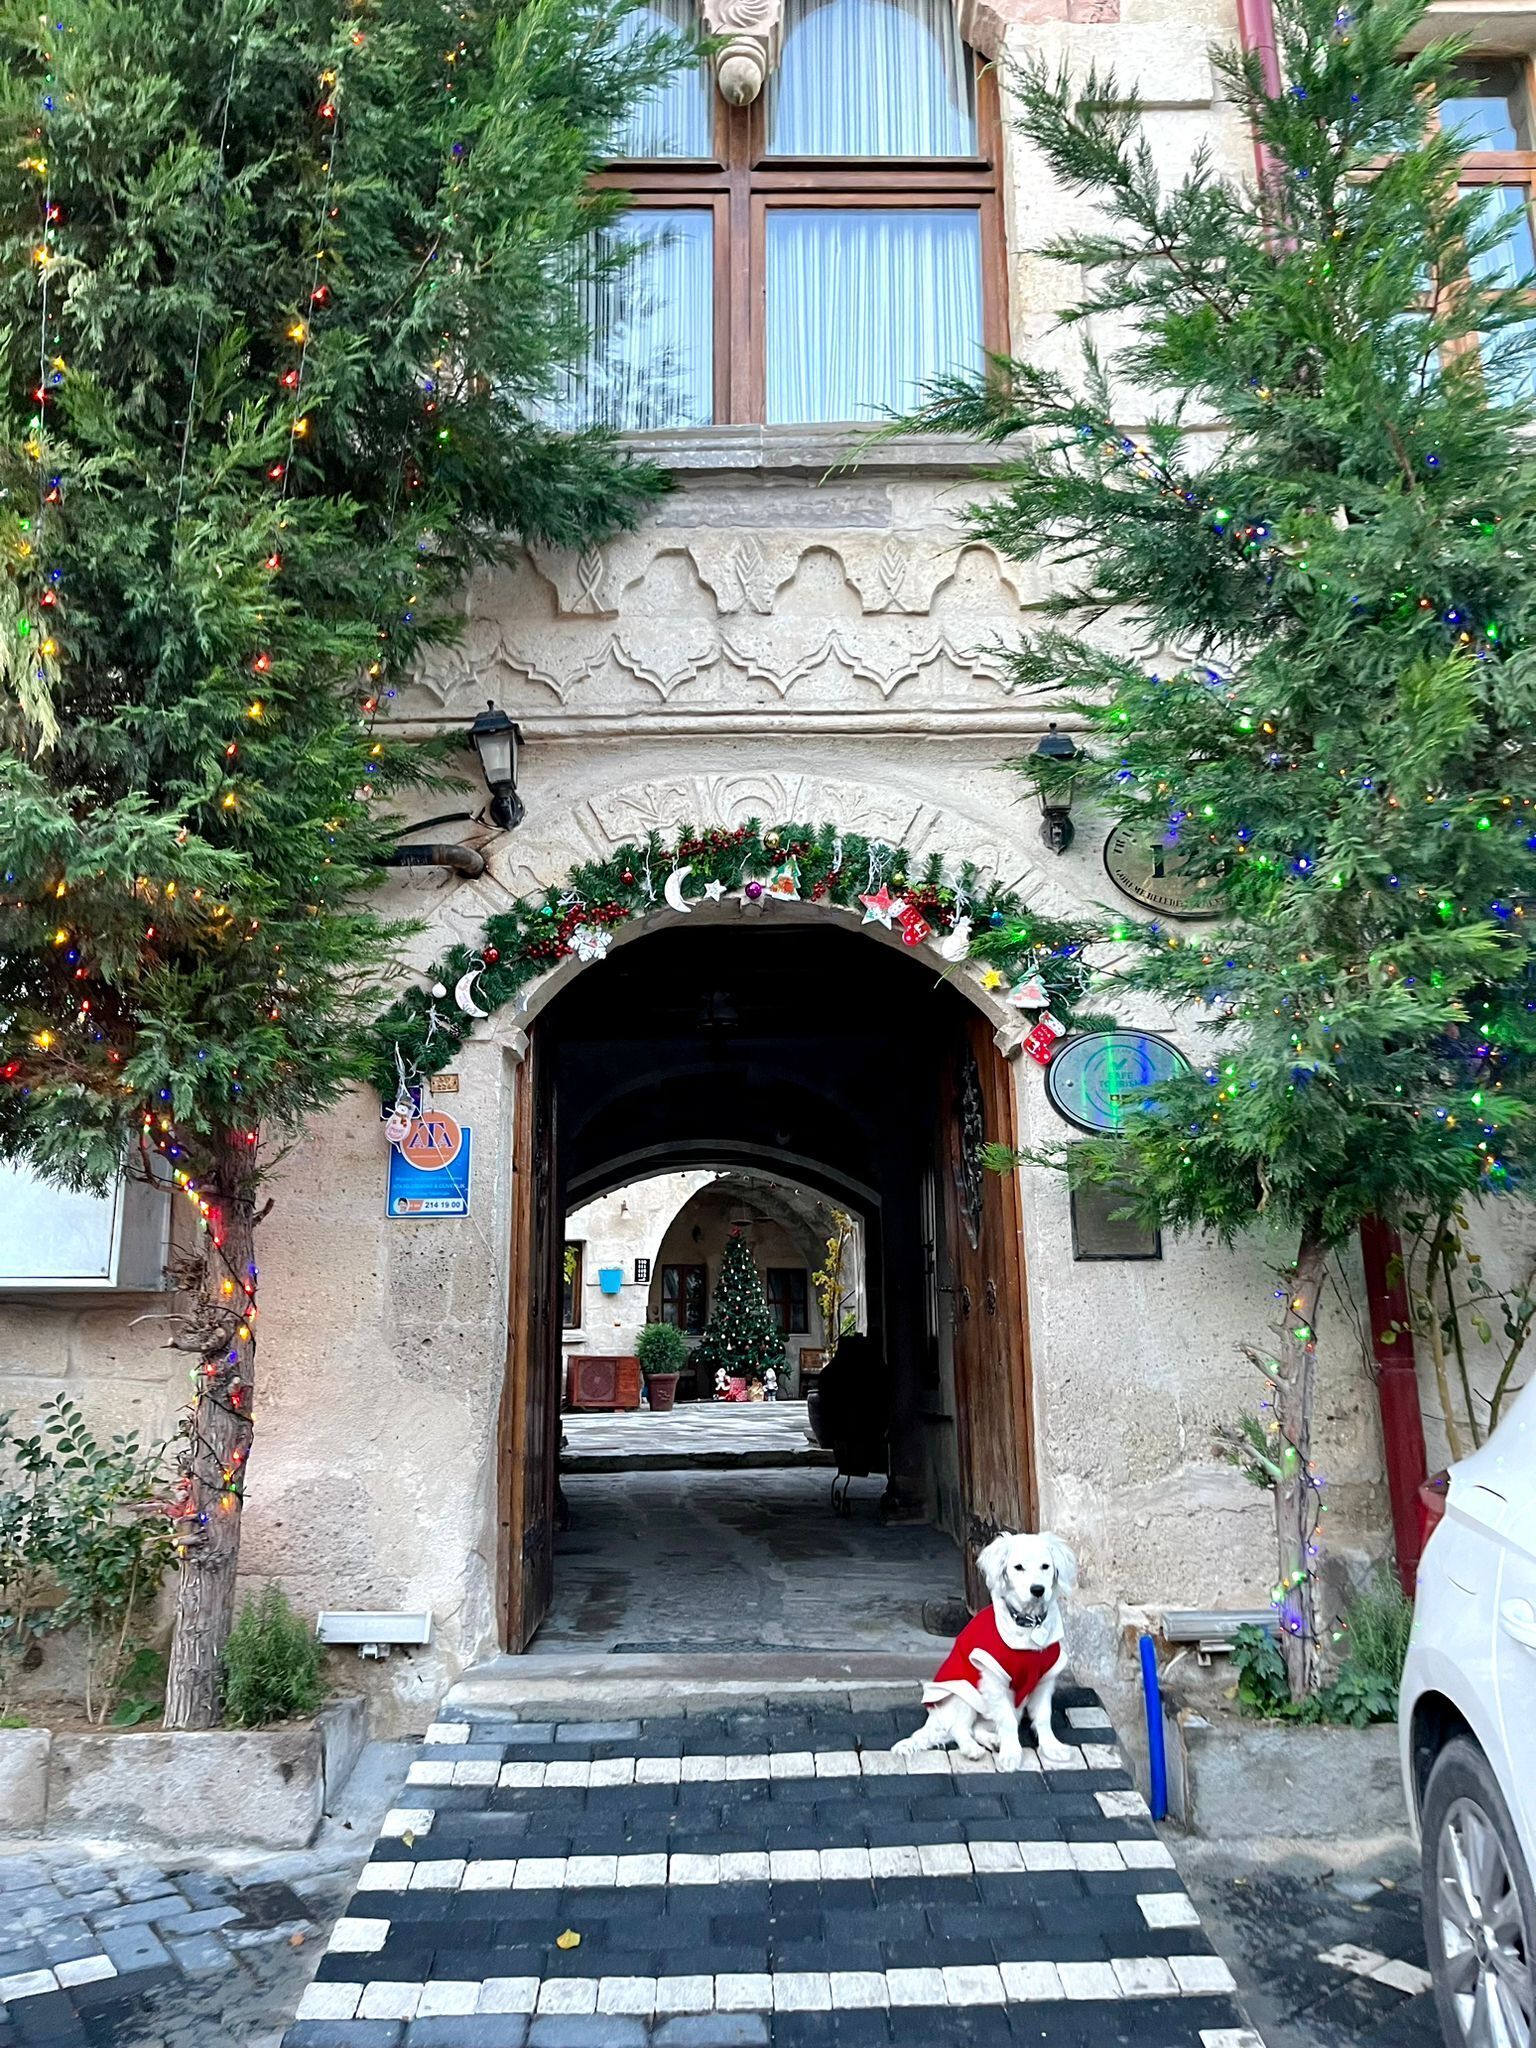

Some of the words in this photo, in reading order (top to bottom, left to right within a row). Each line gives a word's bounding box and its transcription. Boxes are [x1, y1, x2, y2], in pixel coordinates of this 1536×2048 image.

[1108, 1071, 1133, 1080] SAFE
[408, 1121, 454, 1149] ATA
[425, 1201, 439, 1209] 214
[441, 1201, 450, 1209] 19
[451, 1201, 460, 1209] 00
